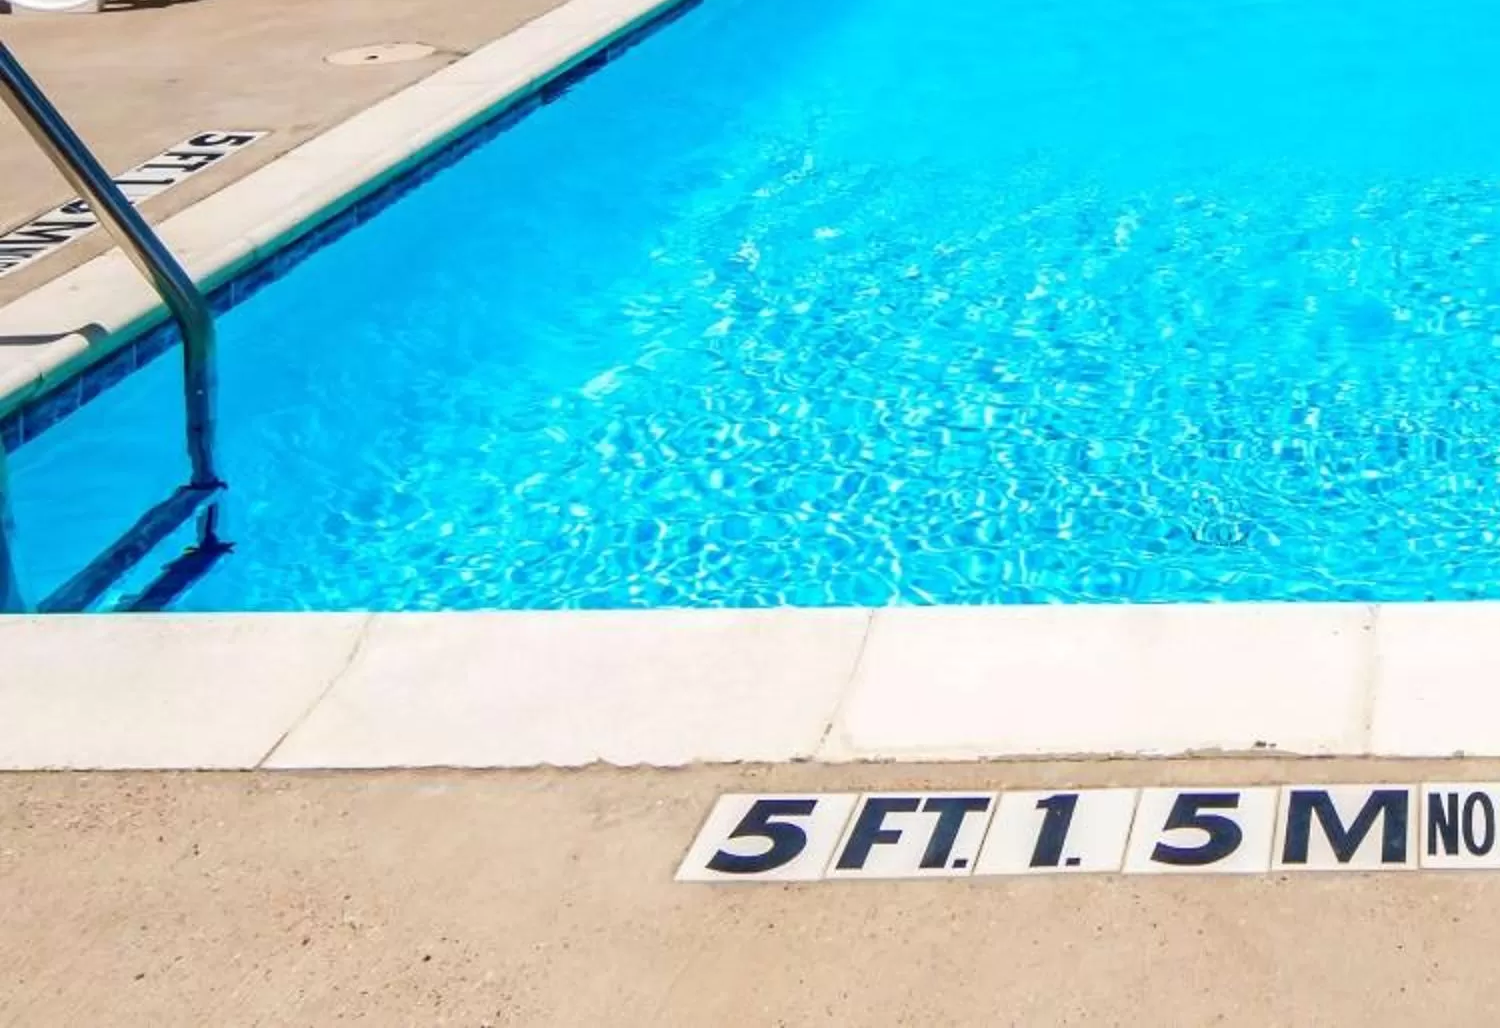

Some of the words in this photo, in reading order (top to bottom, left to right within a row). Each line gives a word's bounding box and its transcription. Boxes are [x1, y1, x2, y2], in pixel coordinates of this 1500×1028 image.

[189, 133, 256, 146] 5
[705, 799, 818, 874] 5
[835, 797, 992, 870] FT.
[1282, 790, 1409, 864] M
[1427, 791, 1496, 856] NO
